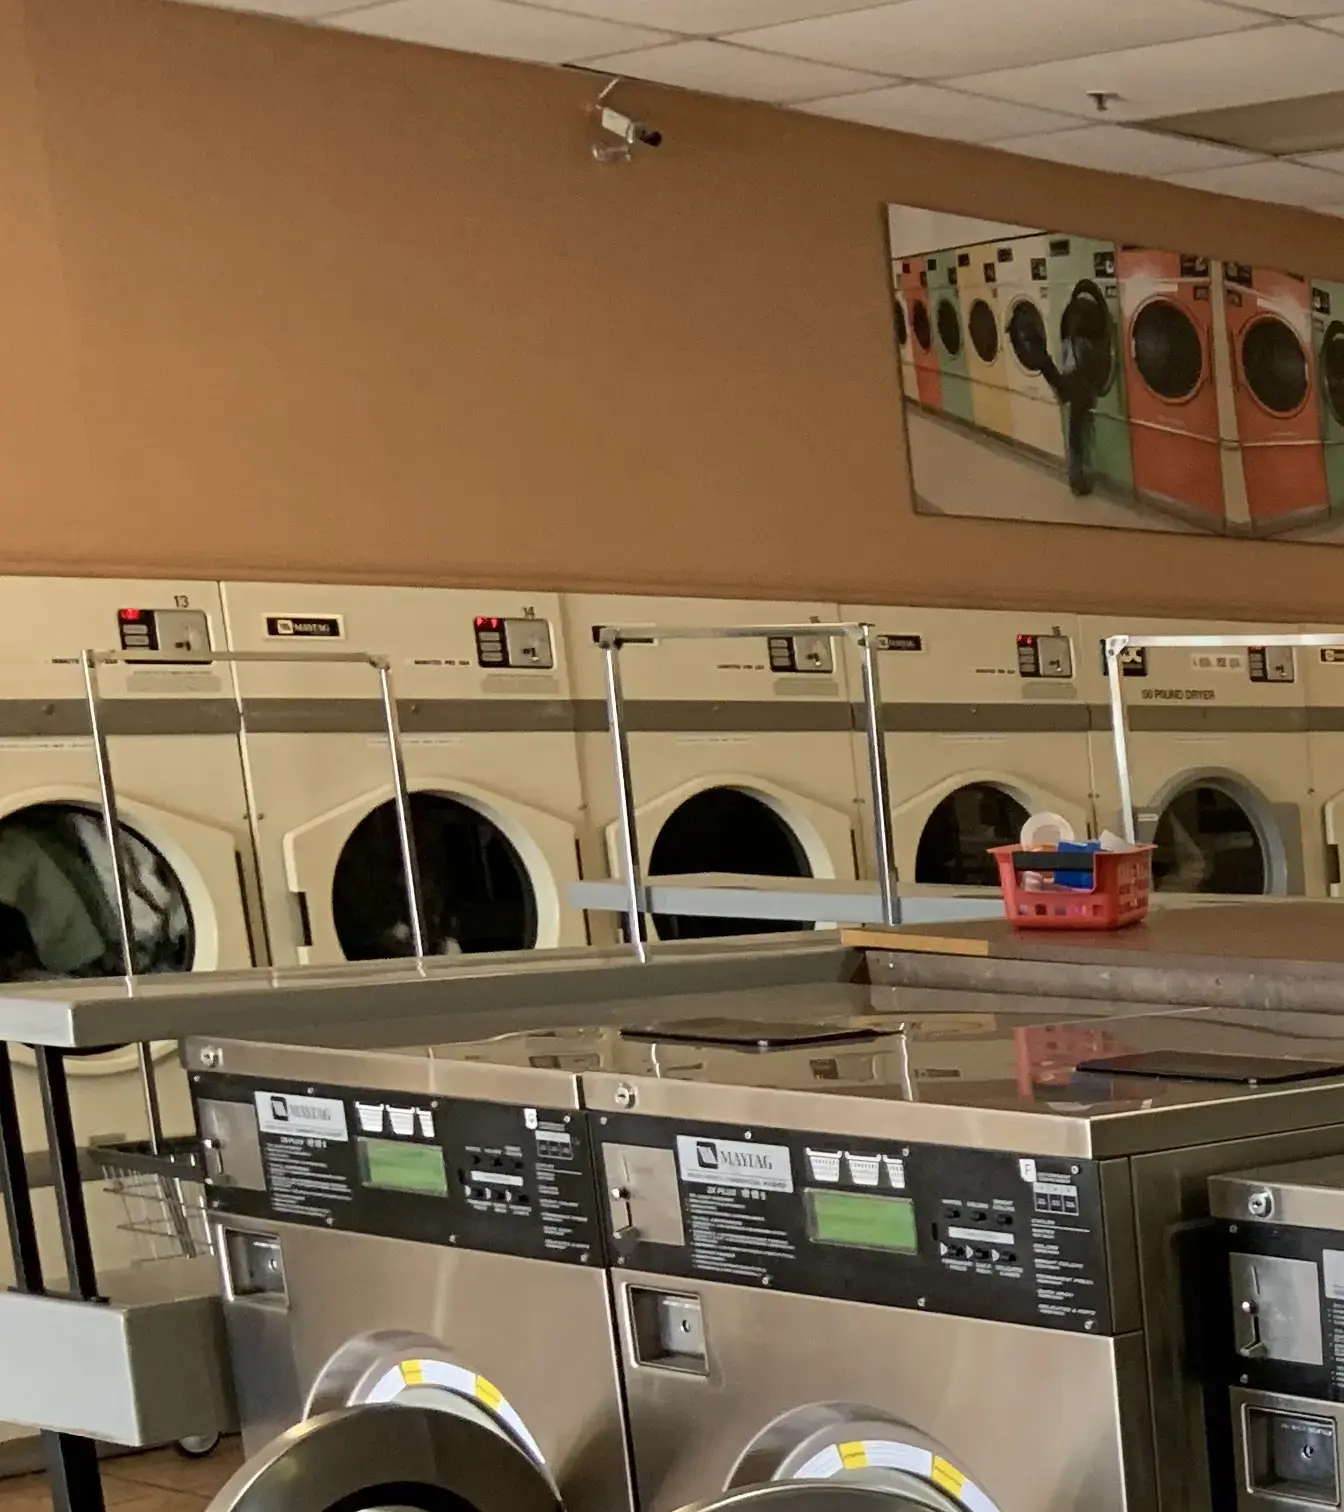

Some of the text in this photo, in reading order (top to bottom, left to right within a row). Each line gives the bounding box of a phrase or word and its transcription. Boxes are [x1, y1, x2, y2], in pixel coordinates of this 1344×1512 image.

[174, 595, 189, 608] 13
[1185, 690, 1215, 700] DRYER
[720, 1150, 773, 1170] MAYTAG
